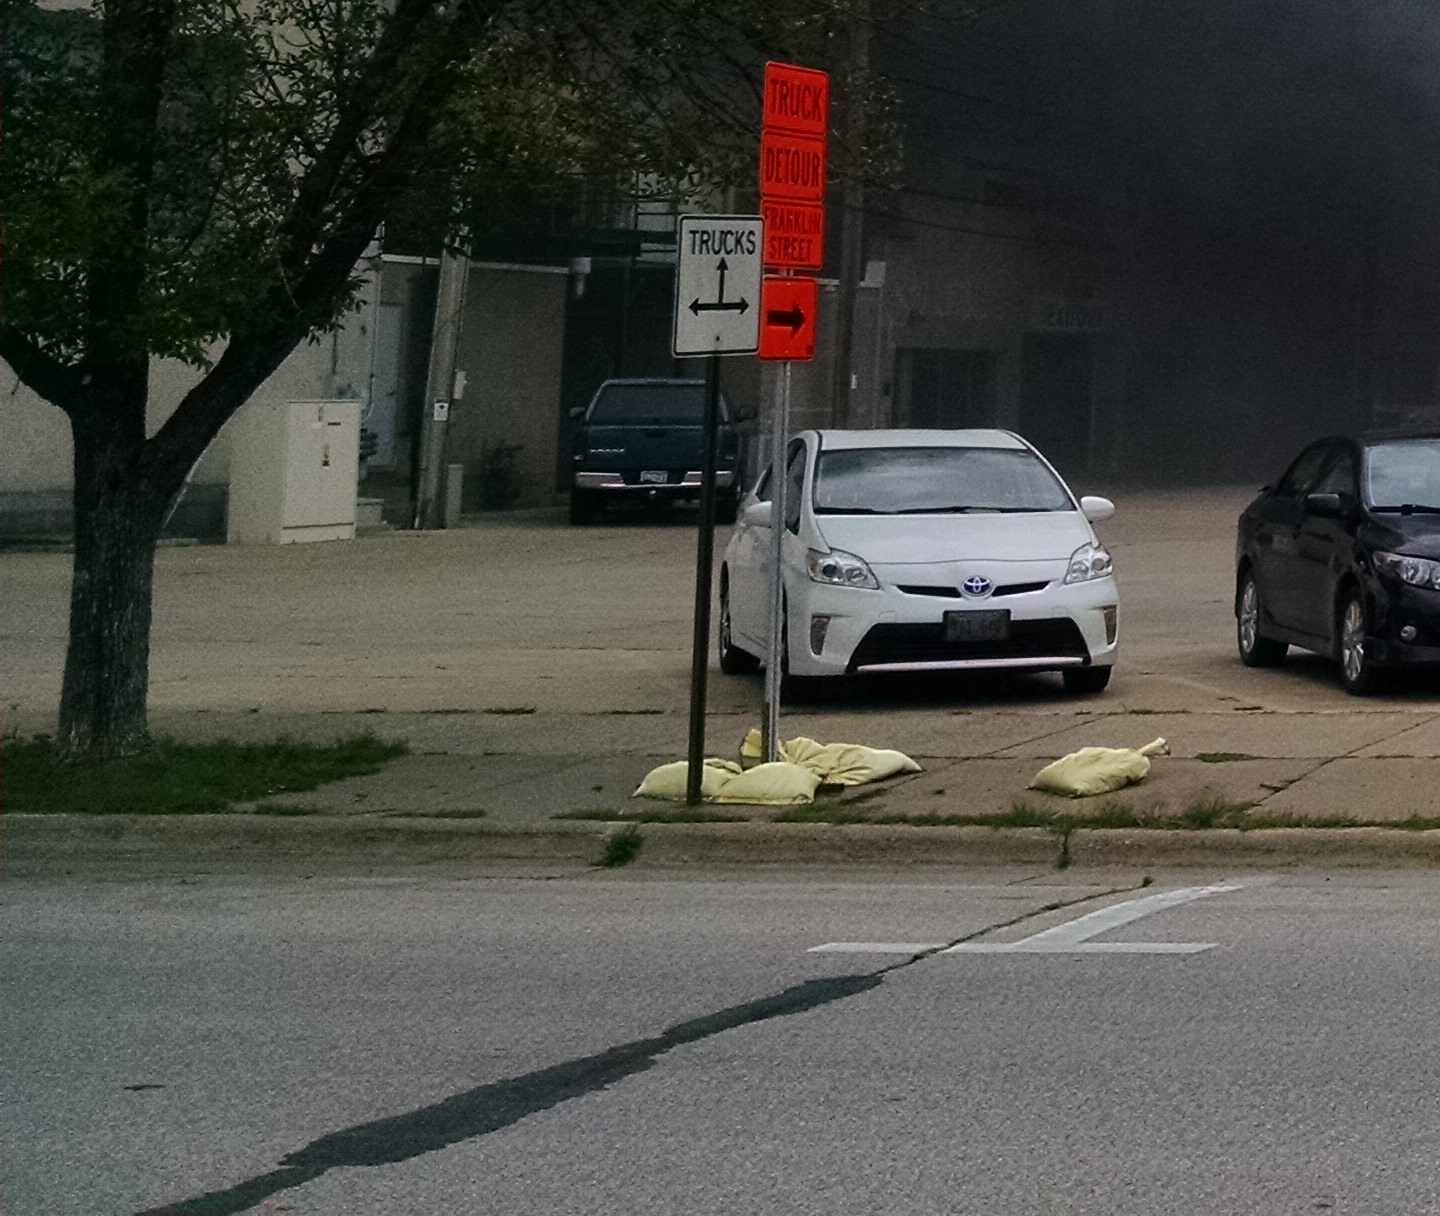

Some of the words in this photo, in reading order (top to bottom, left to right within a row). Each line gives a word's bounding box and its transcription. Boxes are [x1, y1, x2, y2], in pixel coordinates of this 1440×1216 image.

[769, 79, 823, 122] TRUCK
[765, 146, 821, 187] DETOUR
[764, 205, 822, 235] FRANKLIN
[689, 229, 757, 256] TRUCKS
[768, 238, 814, 262] STREET
